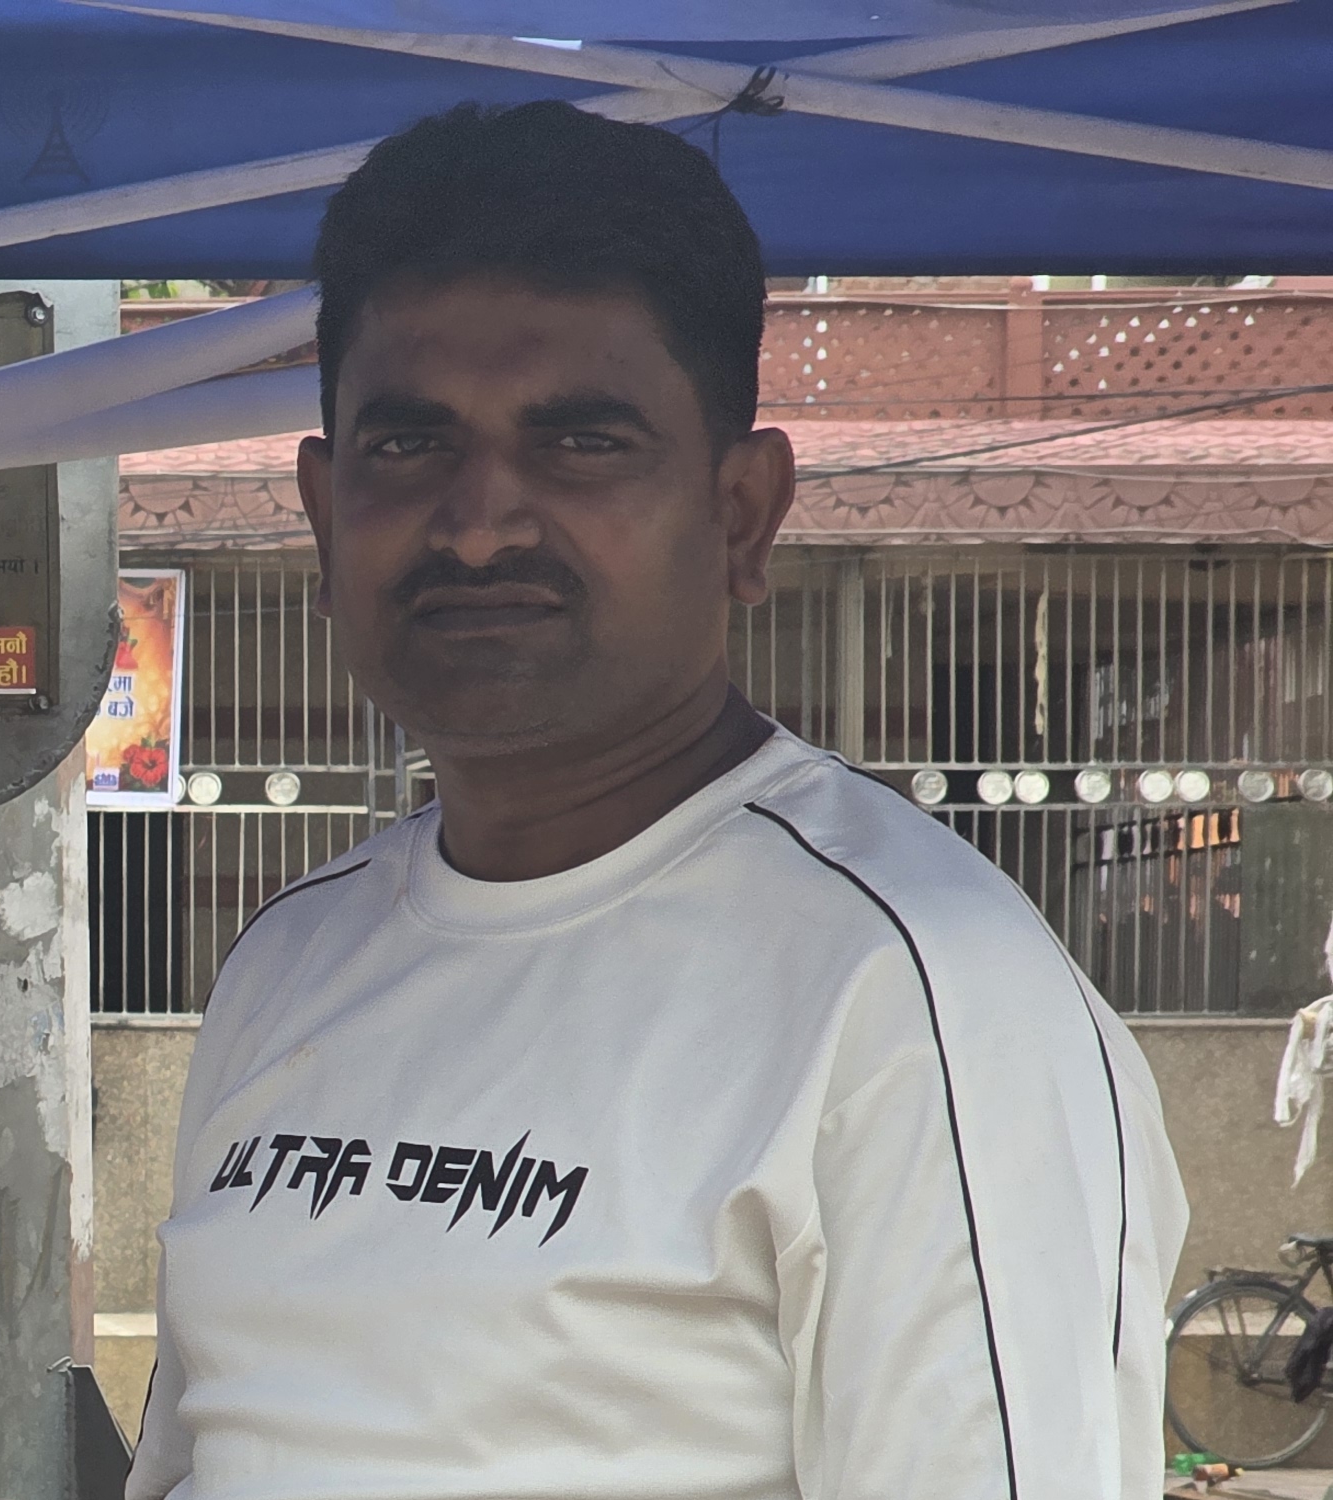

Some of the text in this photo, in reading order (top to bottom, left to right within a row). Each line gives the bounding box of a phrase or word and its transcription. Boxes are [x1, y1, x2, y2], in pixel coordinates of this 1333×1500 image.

[107, 695, 134, 717] बजे
[209, 1128, 590, 1249] ULTRA DENIM
